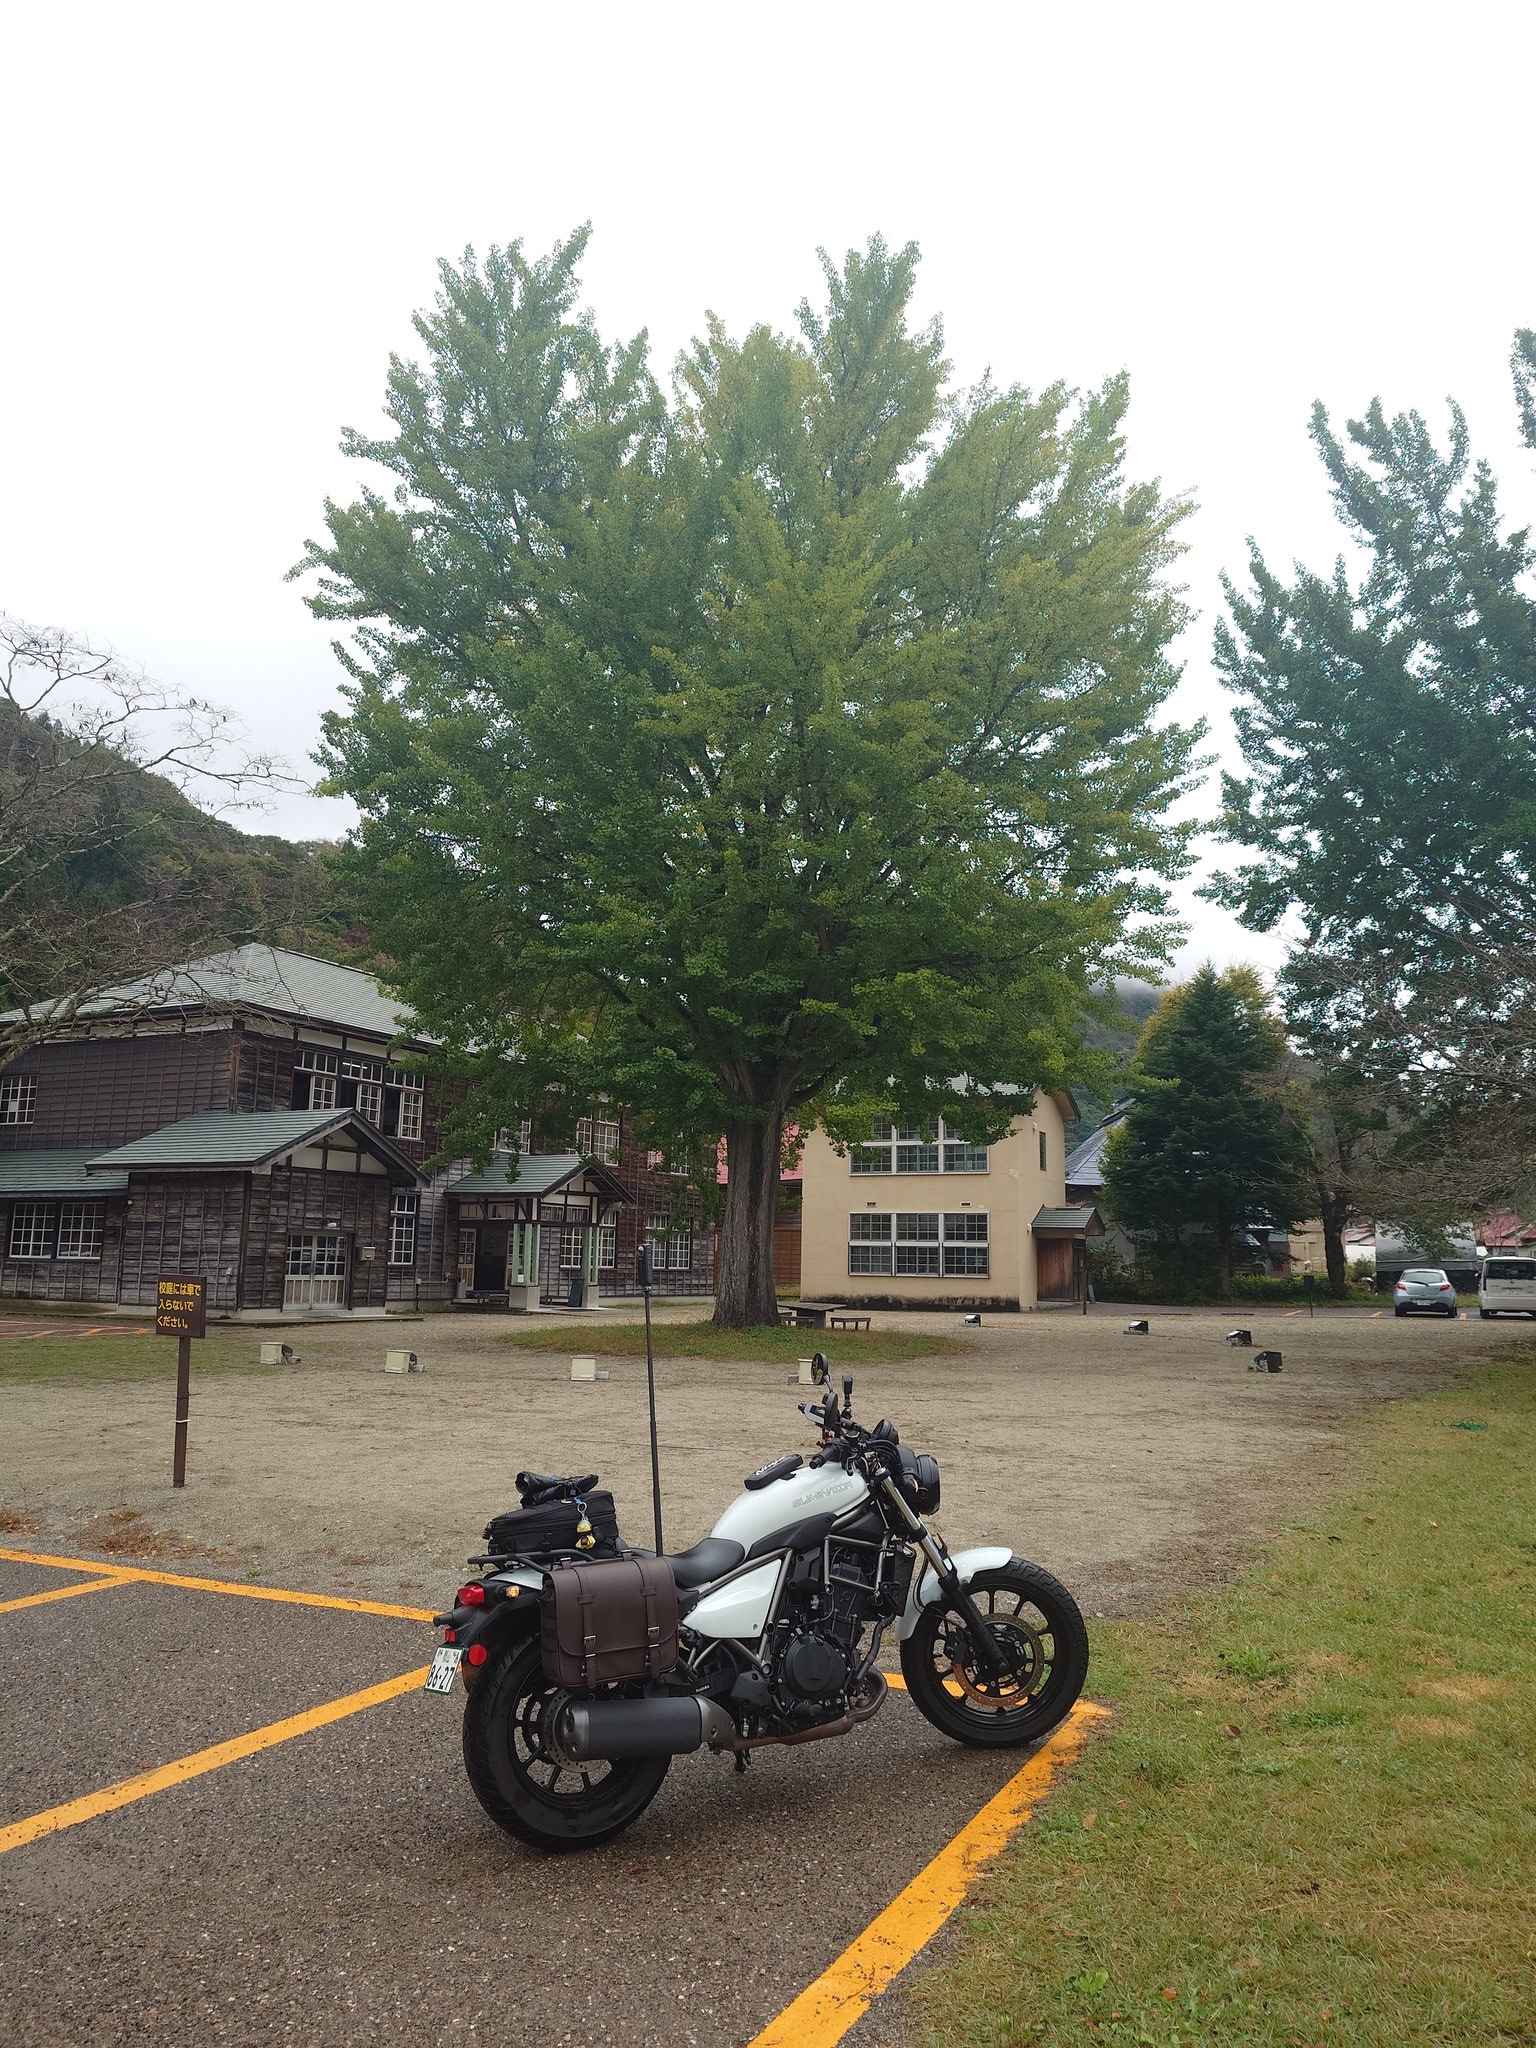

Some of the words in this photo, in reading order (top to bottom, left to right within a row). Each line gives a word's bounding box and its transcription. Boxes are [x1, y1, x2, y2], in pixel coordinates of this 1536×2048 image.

[159, 1281, 201, 1297] 校庭には車で
[158, 1298, 194, 1312] 入らないで
[157, 1315, 189, 1329] ください。
